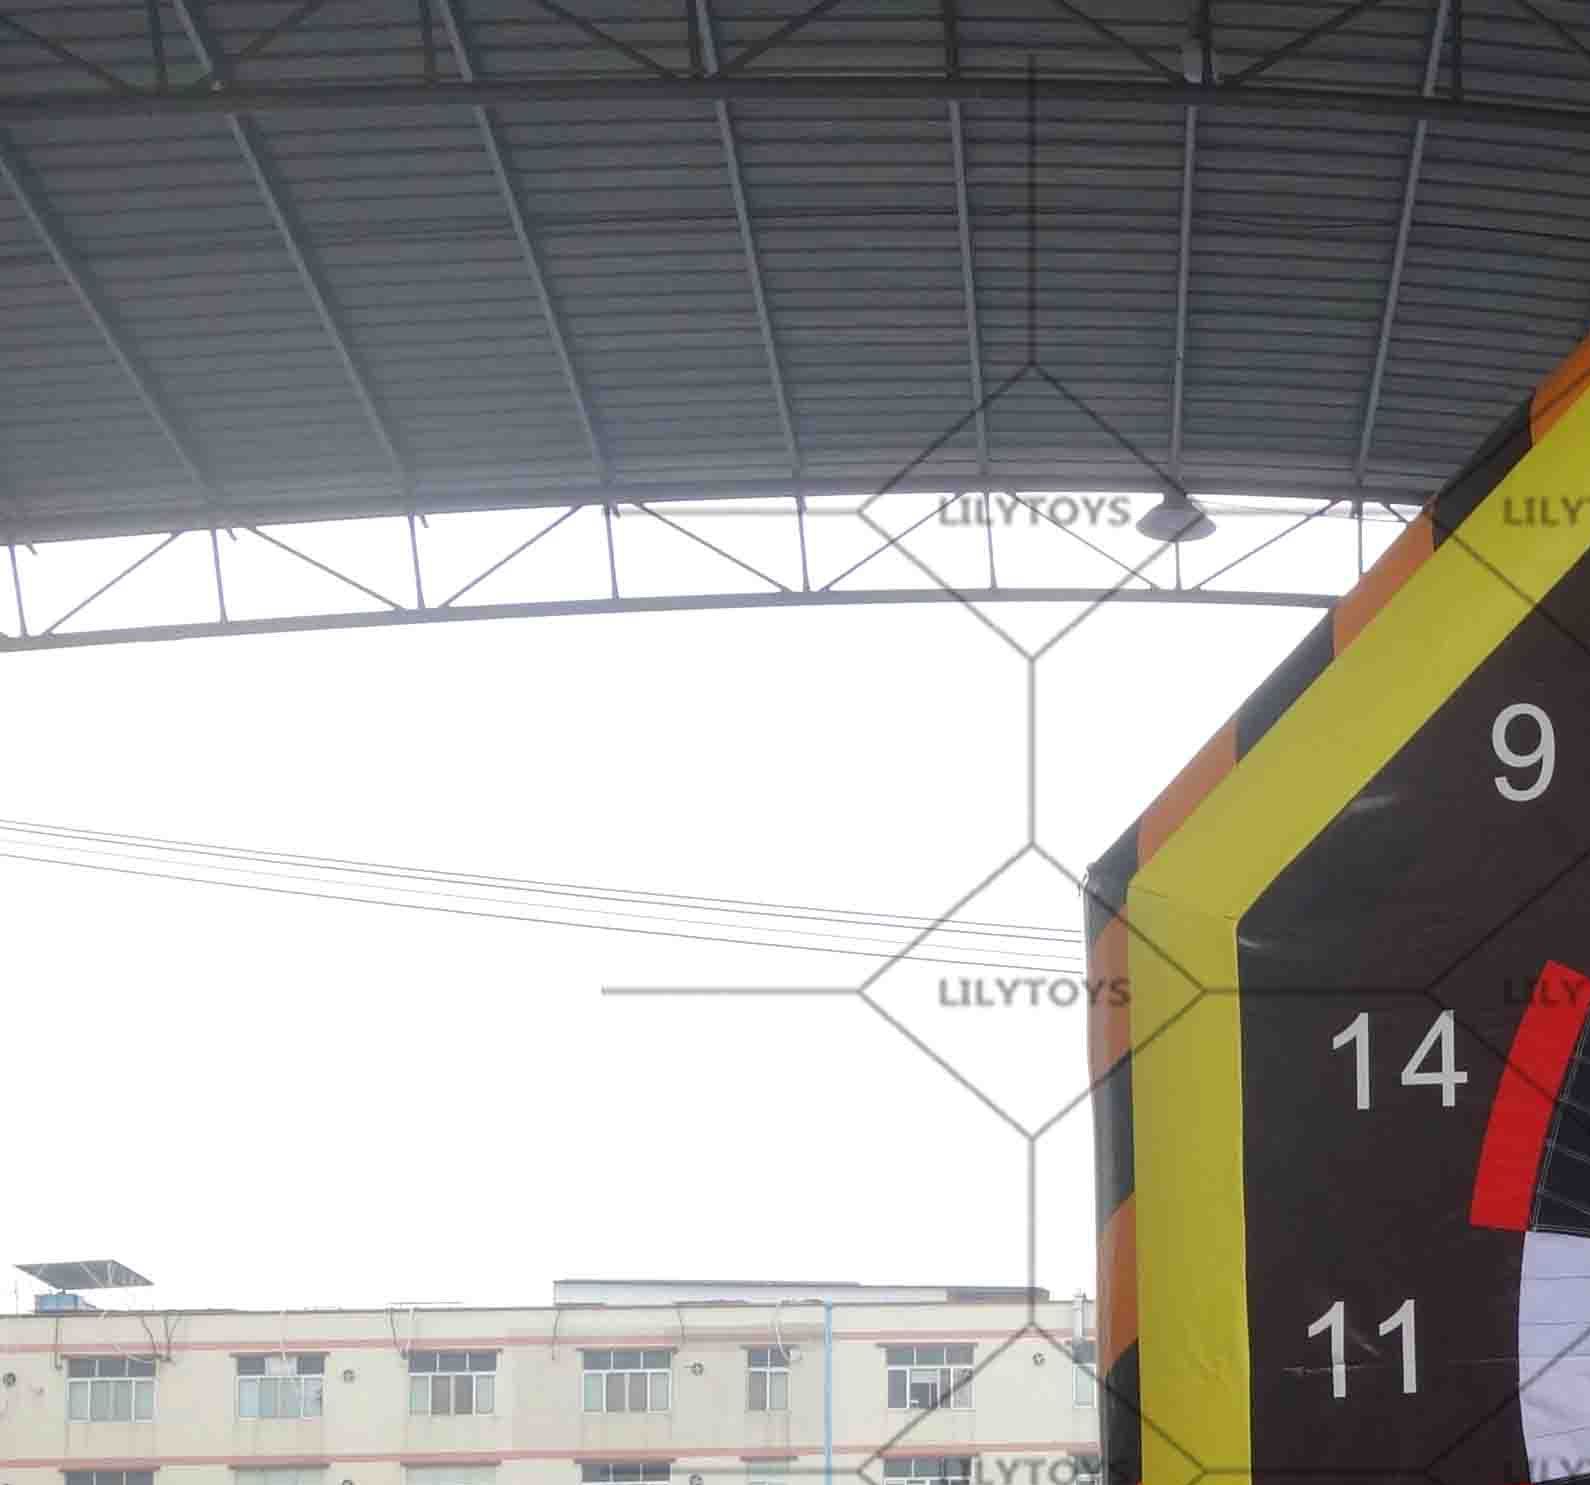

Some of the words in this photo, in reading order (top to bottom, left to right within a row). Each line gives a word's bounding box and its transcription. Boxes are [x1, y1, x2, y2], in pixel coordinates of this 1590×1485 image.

[1490, 702, 1557, 803] 9
[1331, 1008, 1469, 1111] 14
[1307, 1298, 1418, 1400] 11
